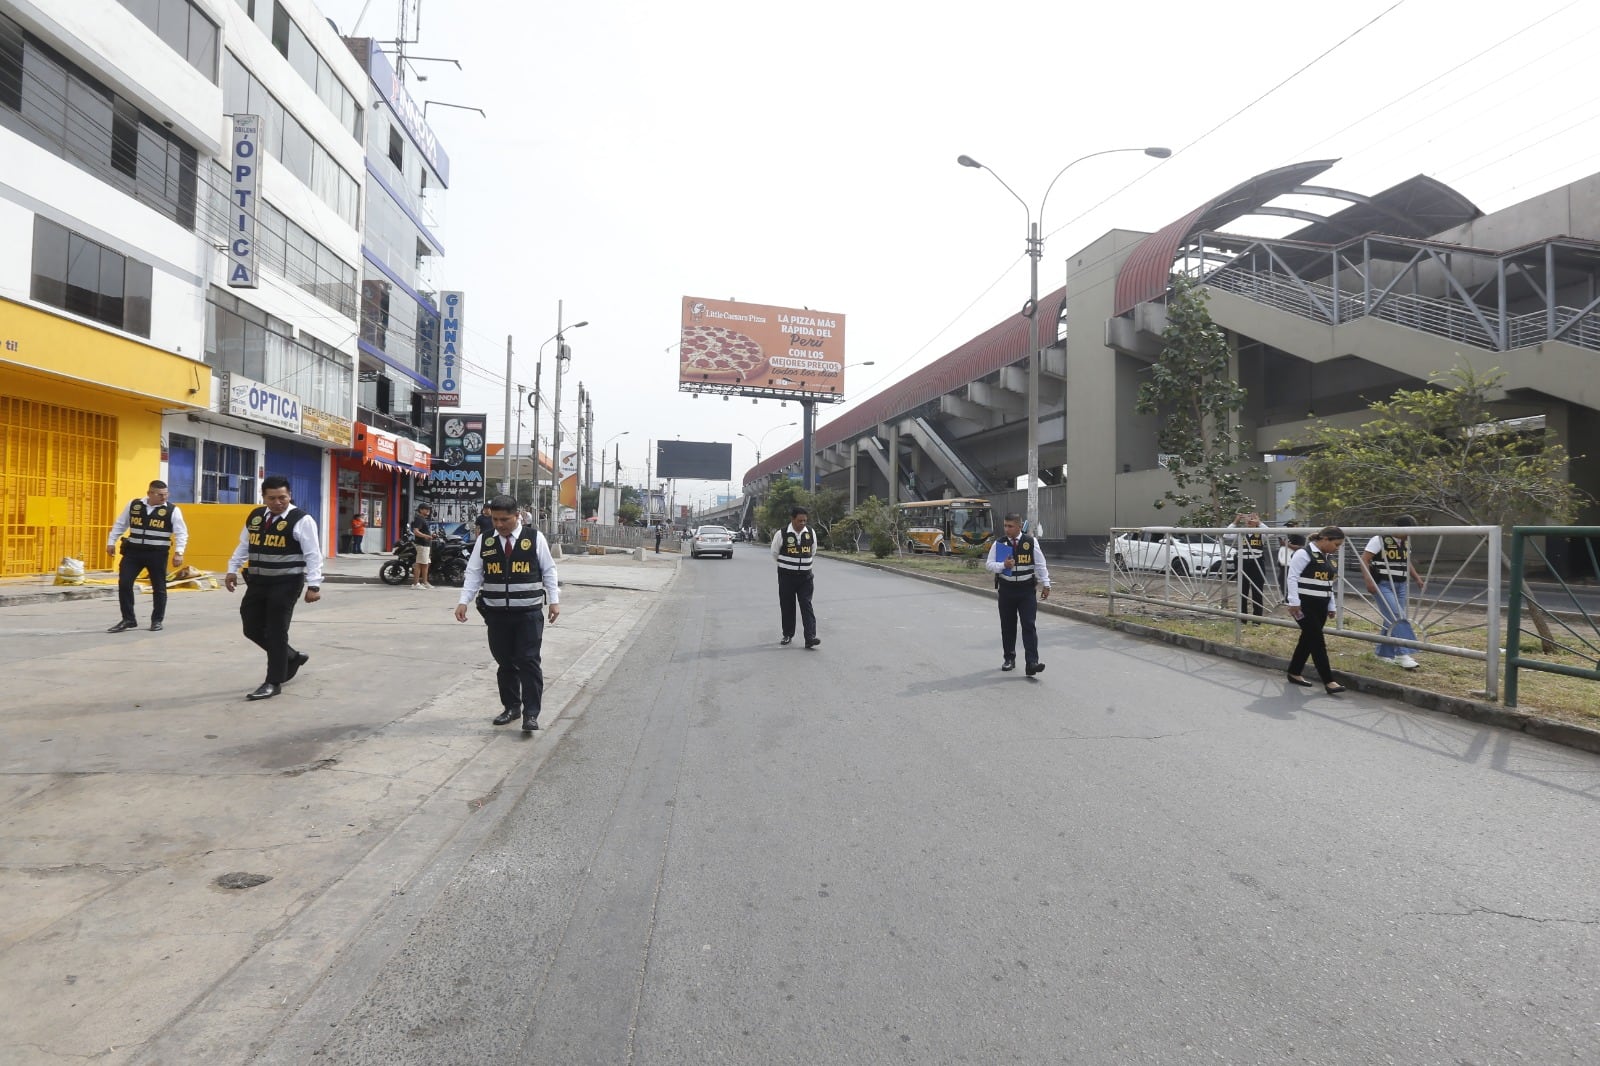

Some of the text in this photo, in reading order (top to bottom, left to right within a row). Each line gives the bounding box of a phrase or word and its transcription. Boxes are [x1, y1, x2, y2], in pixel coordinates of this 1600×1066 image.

[231, 134, 254, 282] ÓPTICA
[777, 314, 790, 323] LA
[790, 315, 816, 327] PIZZA
[816, 329, 833, 338] DEL
[442, 294, 459, 391] GIMNASIO
[788, 348, 824, 360] CON LOS
[771, 357, 840, 371] MEJORES PRECIOS
[249, 382, 298, 421] ÓPTICA
